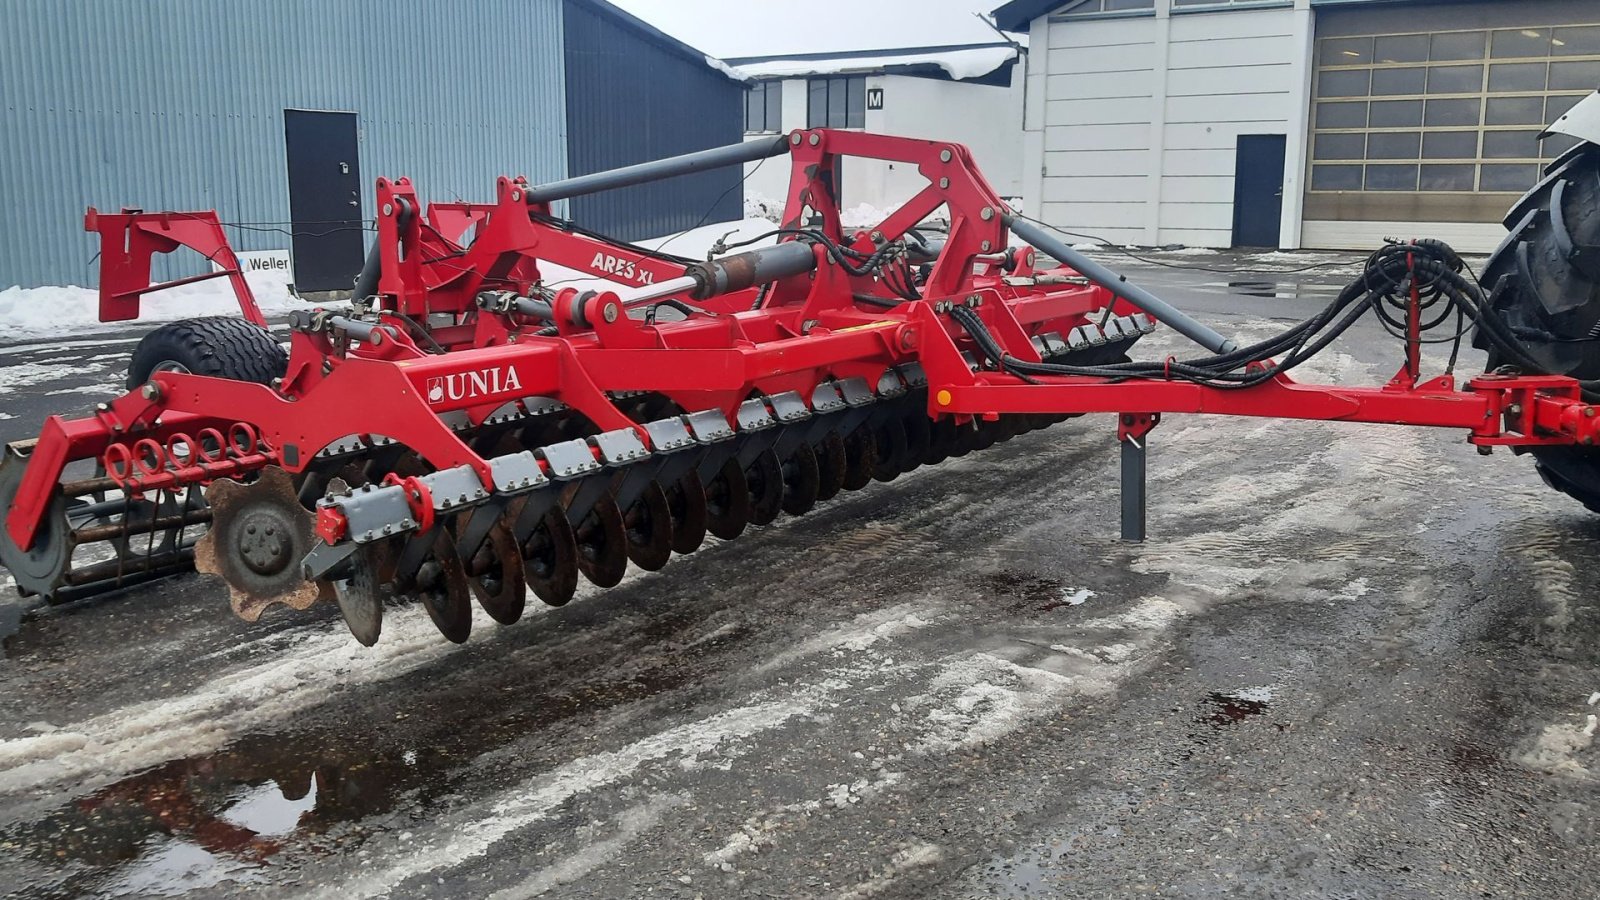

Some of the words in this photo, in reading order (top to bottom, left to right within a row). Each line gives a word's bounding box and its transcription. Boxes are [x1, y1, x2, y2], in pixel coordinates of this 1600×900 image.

[869, 91, 882, 107] M
[249, 257, 288, 271] Weller
[590, 252, 636, 279] ARES
[636, 269, 655, 285] XL
[445, 365, 522, 400] UNIA
